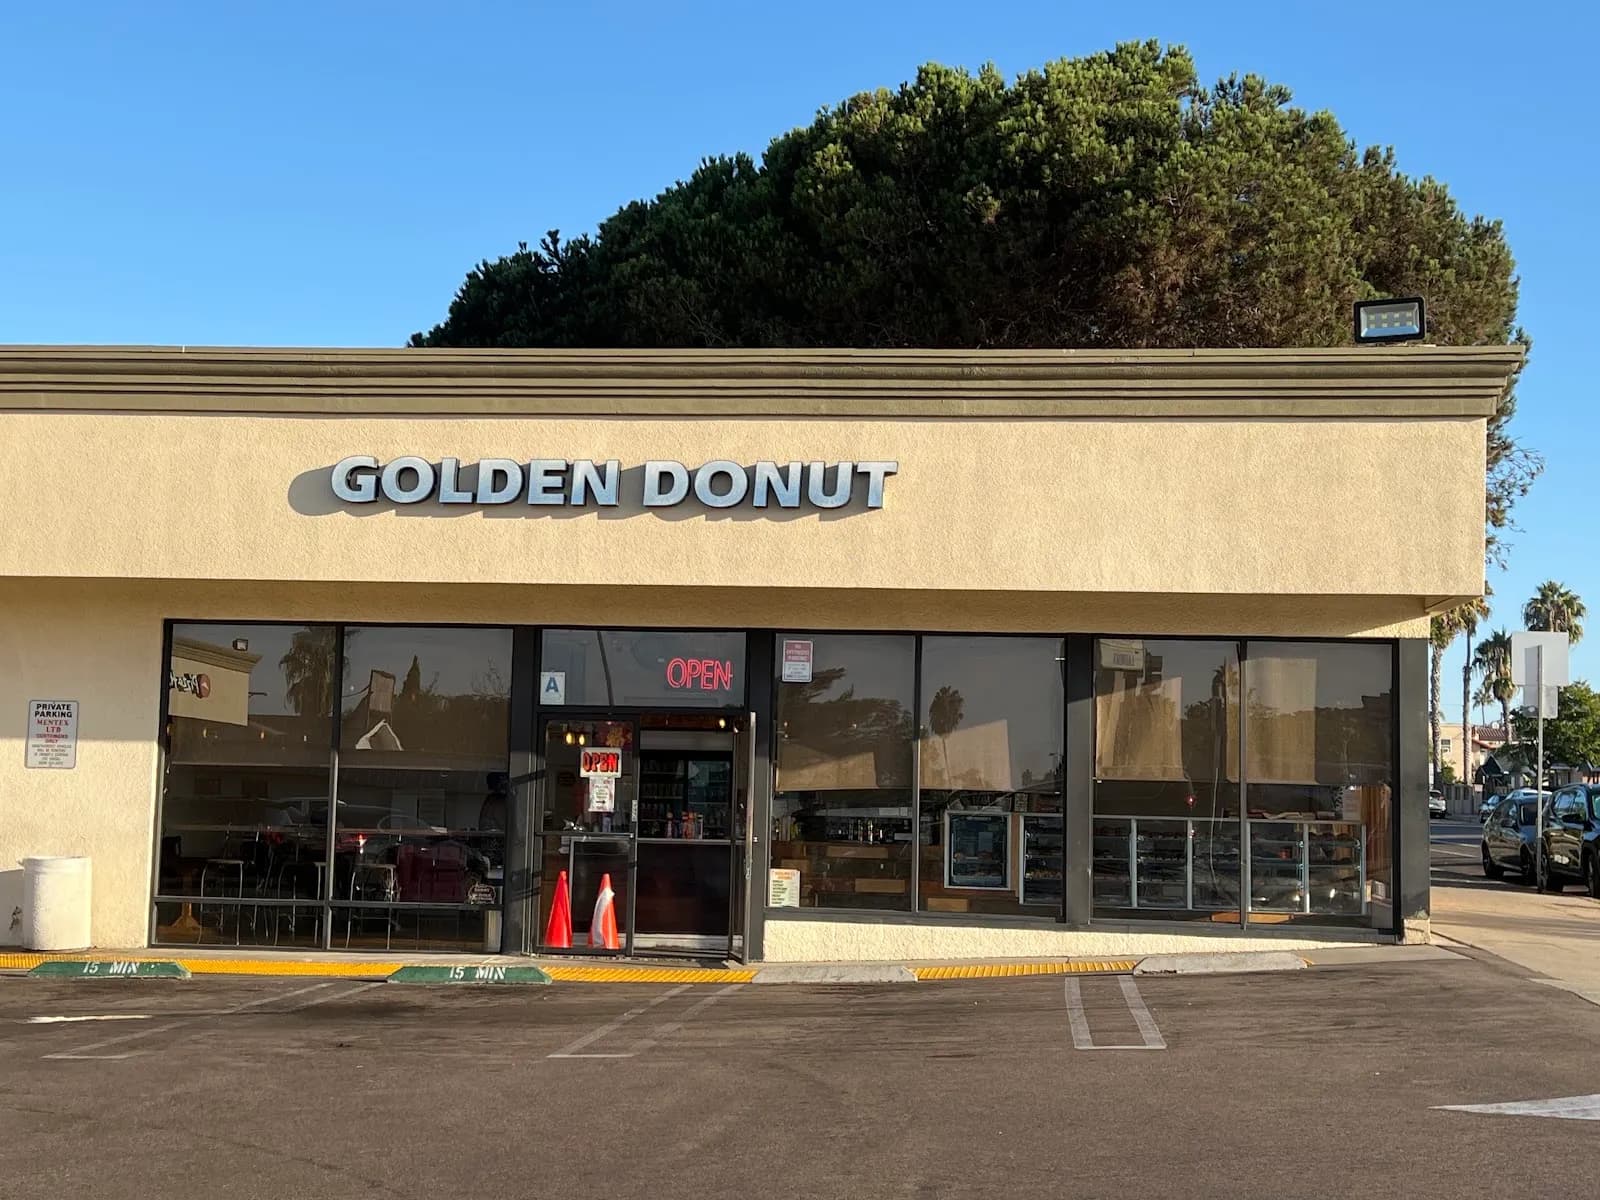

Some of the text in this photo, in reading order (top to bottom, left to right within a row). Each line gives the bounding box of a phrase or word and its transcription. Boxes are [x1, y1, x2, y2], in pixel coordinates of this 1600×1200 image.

[331, 455, 899, 509] GOLDEN DONUT
[667, 657, 733, 692] OPEN
[545, 677, 559, 692] A
[36, 703, 72, 711] PRIVATE
[582, 751, 620, 773] OPEN
[83, 961, 140, 974] 15 MIN
[449, 966, 506, 980] 15 MIN
